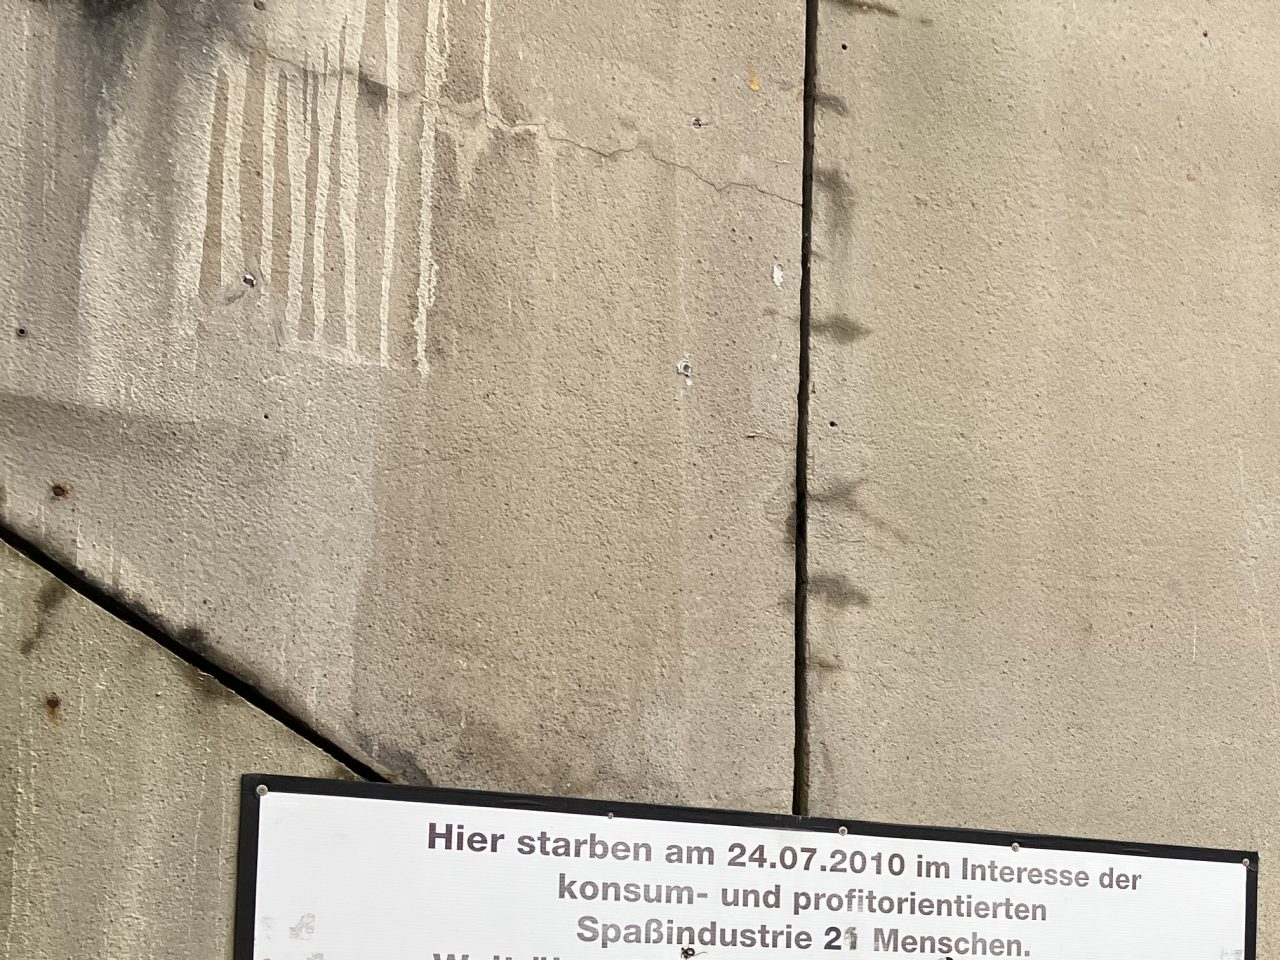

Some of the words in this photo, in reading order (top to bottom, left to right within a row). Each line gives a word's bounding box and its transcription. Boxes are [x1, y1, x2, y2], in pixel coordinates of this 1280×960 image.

[428, 823, 505, 852] Hier
[517, 831, 651, 861] starben
[665, 845, 714, 865] am
[728, 842, 905, 876] 24.07.2010
[917, 854, 950, 879] im
[962, 857, 1089, 887] Interesse
[1099, 867, 1141, 890] der
[559, 873, 708, 904] konsum-
[722, 884, 780, 908] und
[794, 889, 1046, 921] profitorientierten
[577, 916, 812, 949] Spaßindustrie
[874, 928, 1030, 956] Menschen.
